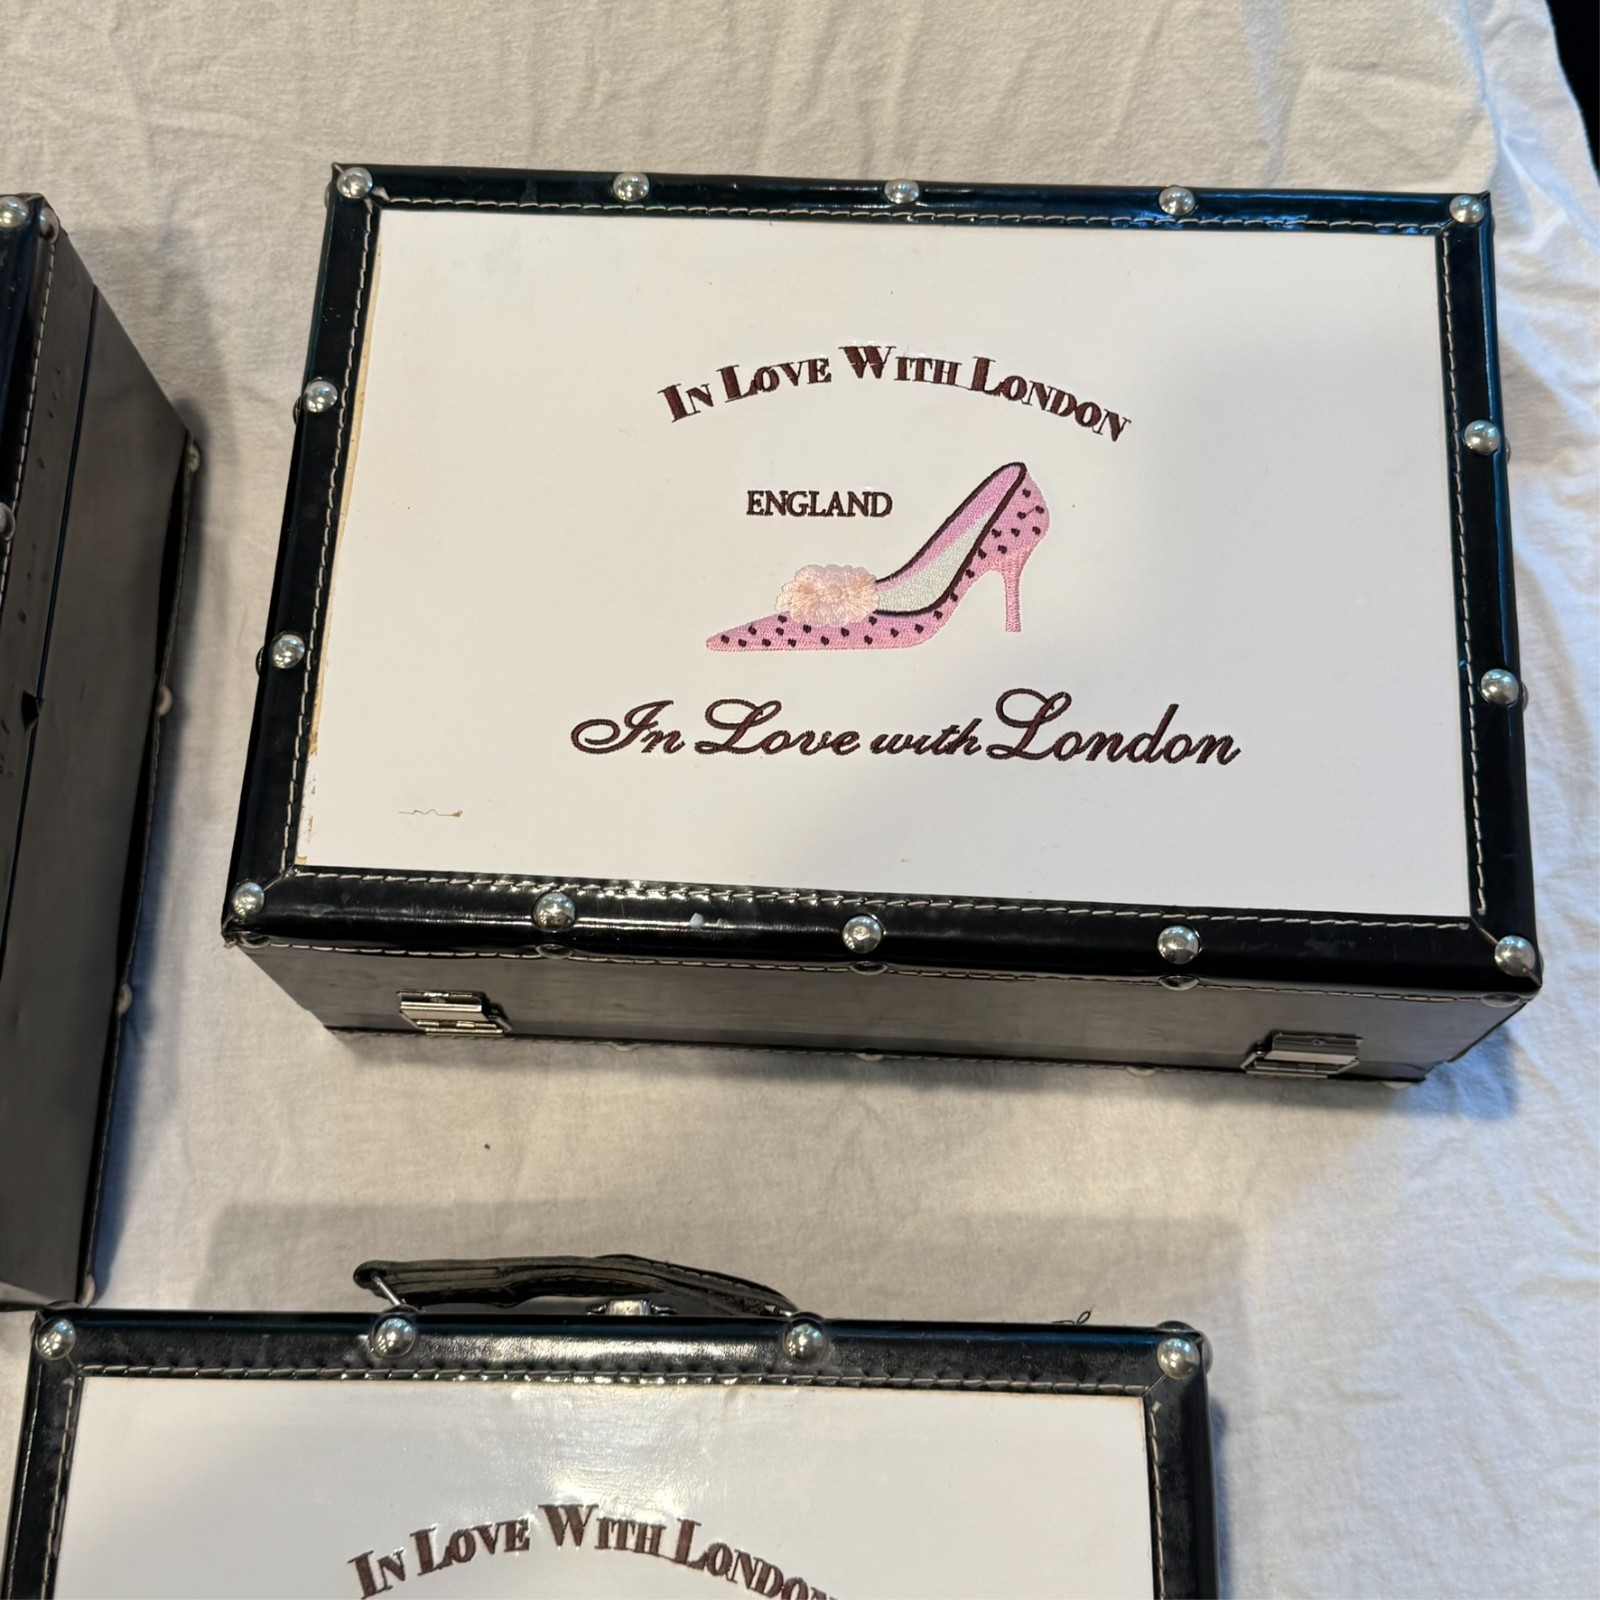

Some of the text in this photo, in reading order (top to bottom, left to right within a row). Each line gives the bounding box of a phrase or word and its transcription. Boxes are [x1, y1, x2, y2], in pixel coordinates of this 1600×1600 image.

[657, 345, 1132, 442] IN LOVE WITH LONDON
[746, 490, 893, 518] ENGLAND
[570, 687, 1242, 766] In Love with London
[347, 1549, 406, 1600] IN
[410, 1517, 530, 1576] LOVE
[538, 1504, 666, 1557] WITH
